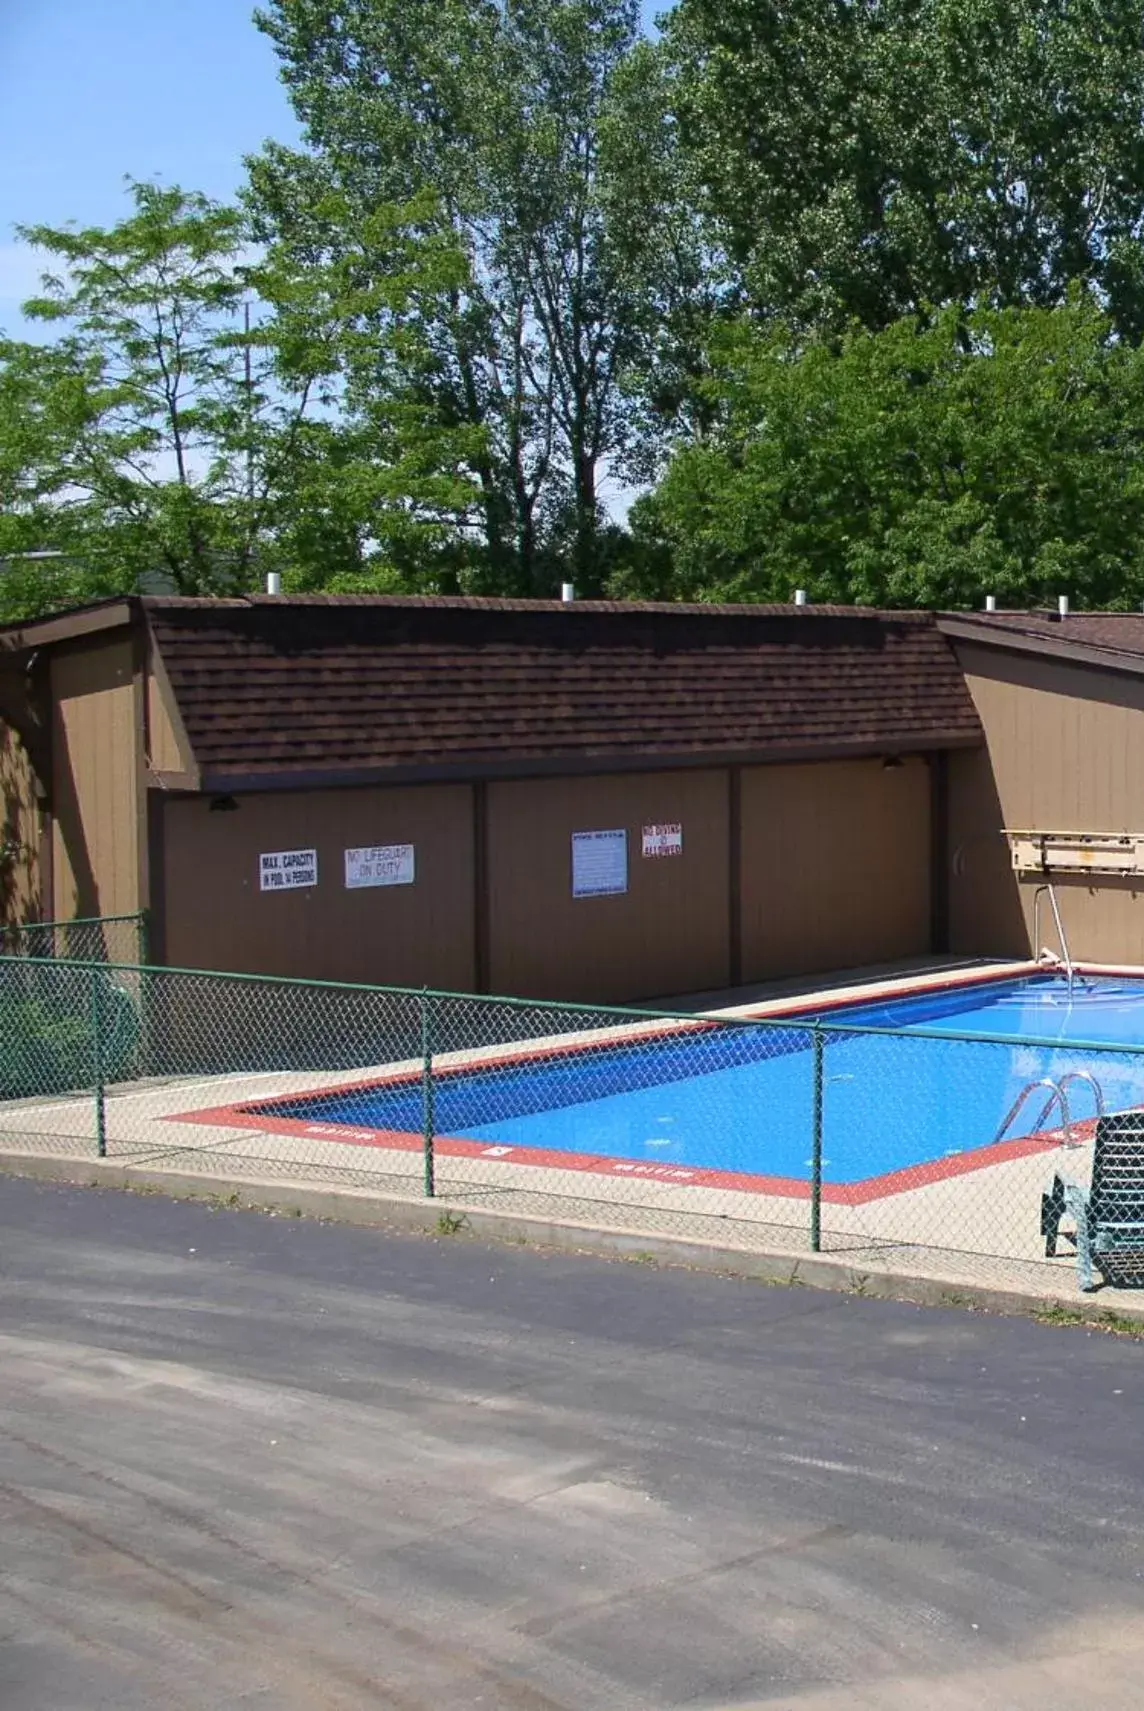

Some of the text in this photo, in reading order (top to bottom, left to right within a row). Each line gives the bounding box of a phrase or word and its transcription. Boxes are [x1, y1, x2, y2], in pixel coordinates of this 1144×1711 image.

[643, 823, 681, 836] NO DIVING
[644, 843, 681, 856] ALLOWED
[283, 853, 314, 868] CAPACITY
[360, 861, 402, 877] ON DUTY
[271, 872, 284, 886] POOL
[292, 869, 314, 884] PERSONS
